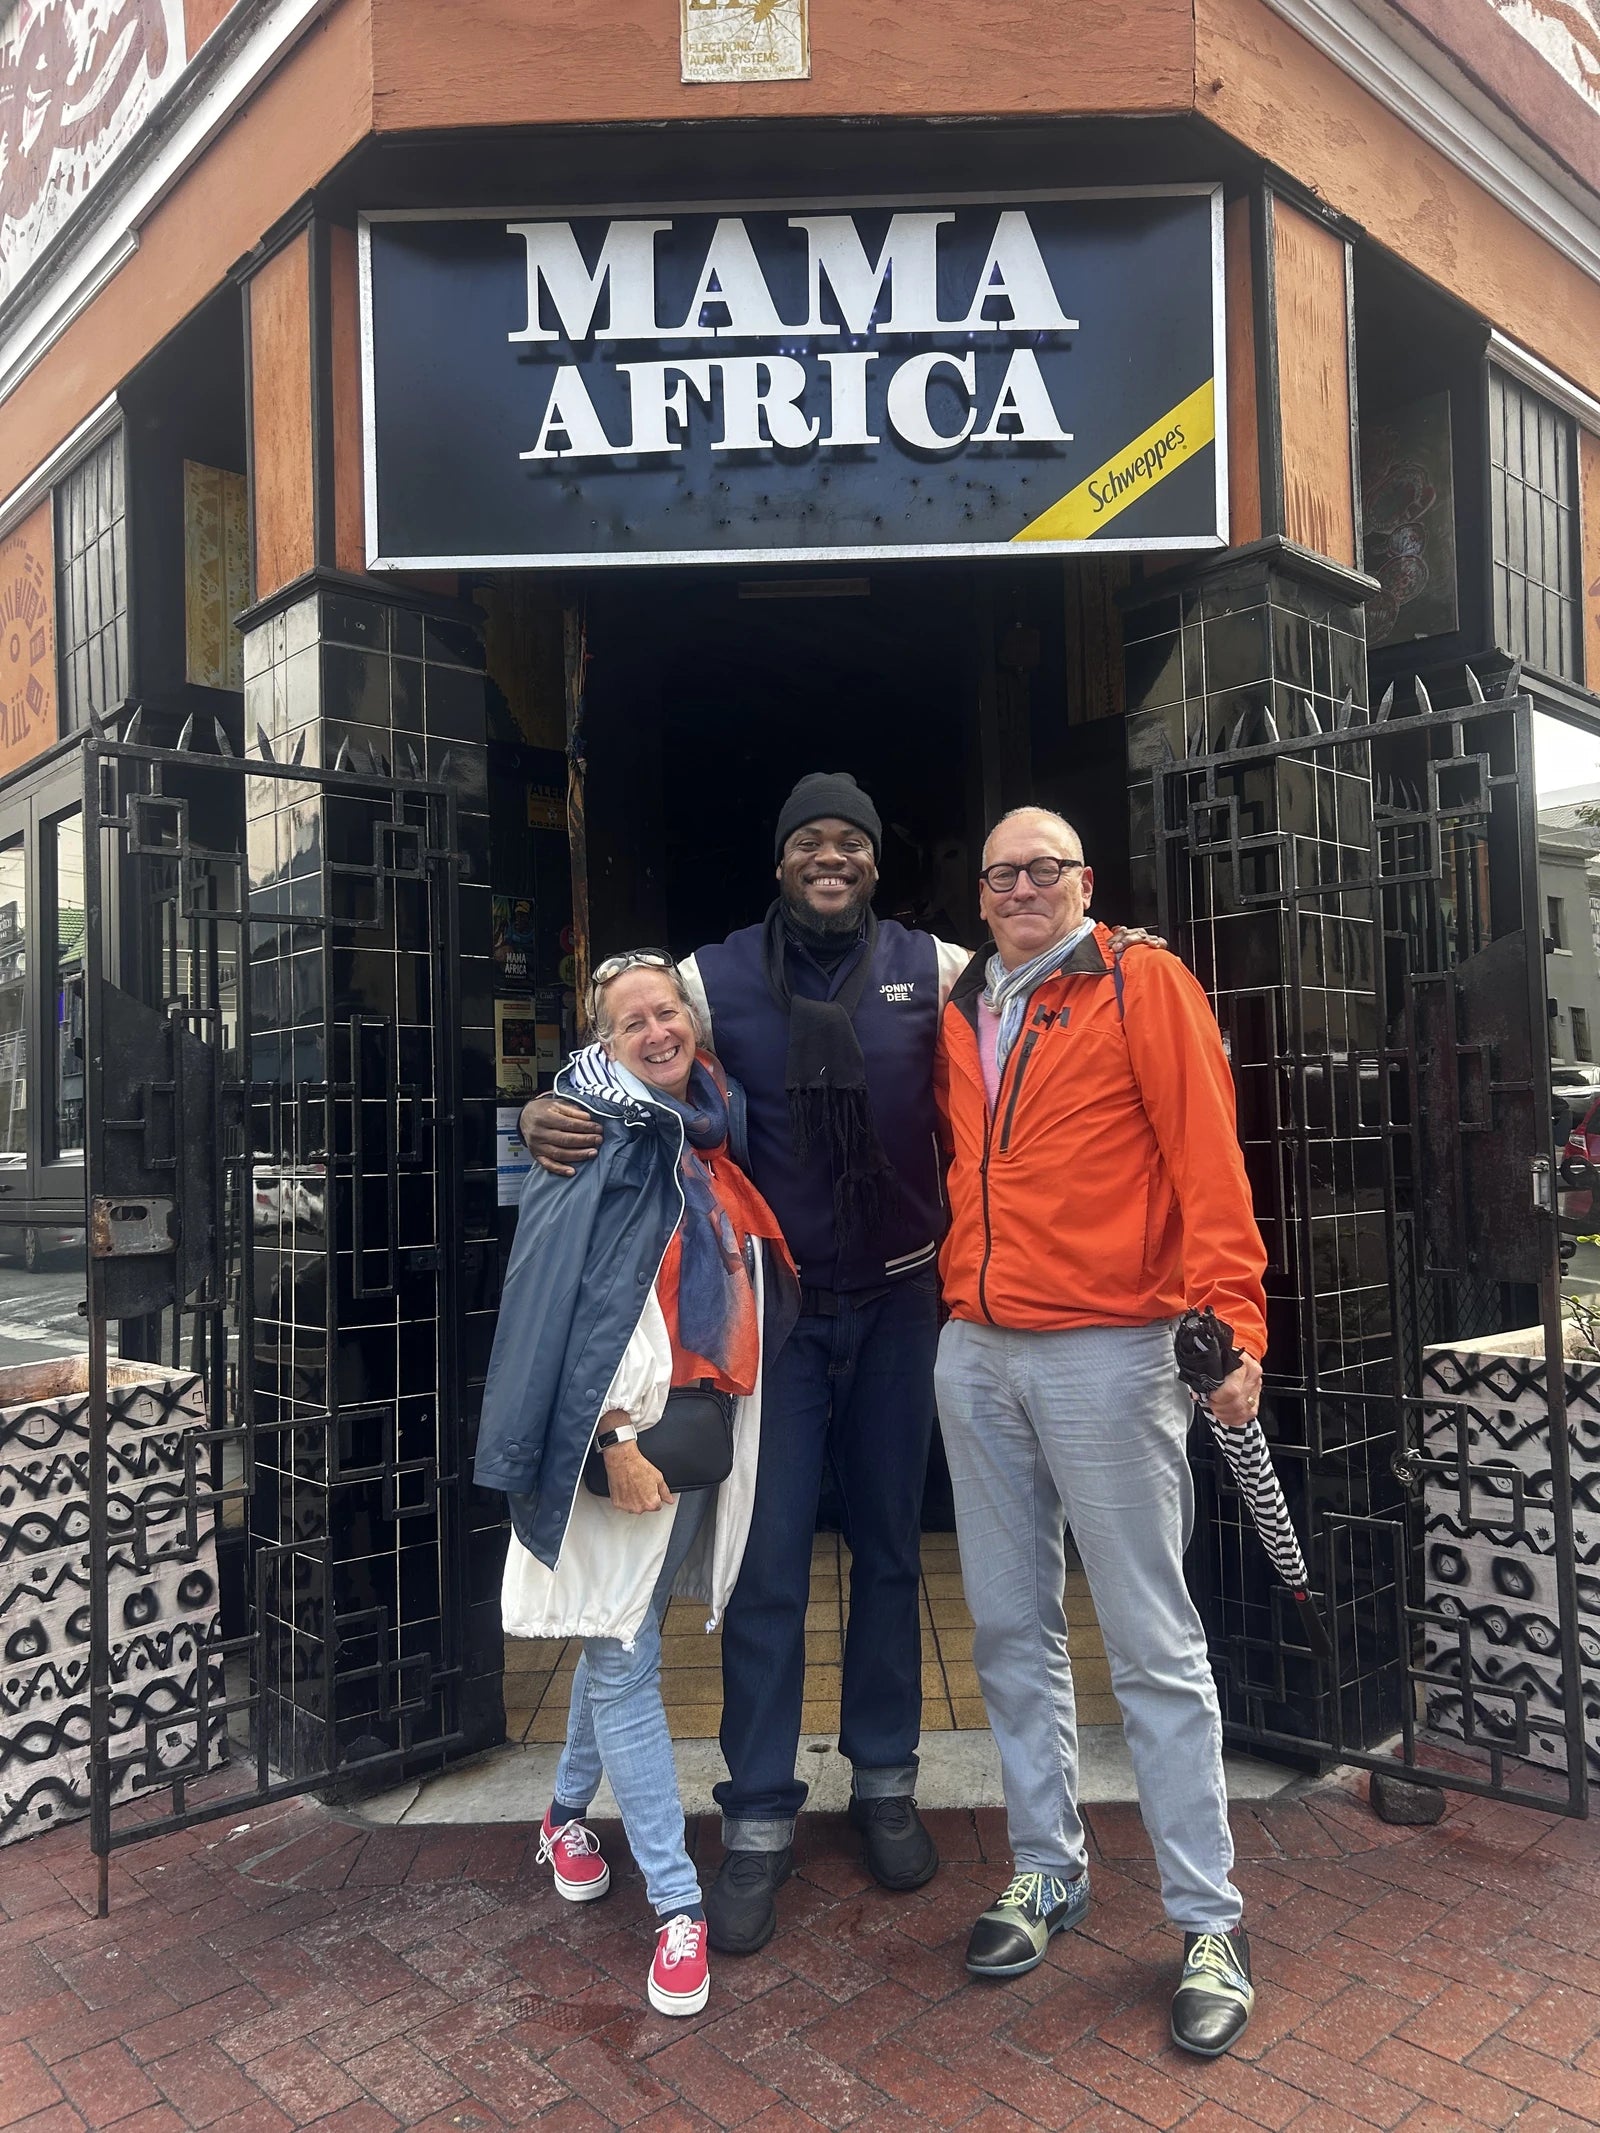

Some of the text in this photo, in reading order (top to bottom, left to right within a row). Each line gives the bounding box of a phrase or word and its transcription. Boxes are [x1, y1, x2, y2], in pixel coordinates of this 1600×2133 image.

[689, 41, 756, 53] ELECTRONIC
[690, 52, 780, 66] ALARM SYSTEMS
[506, 211, 1079, 342] MAMA
[519, 348, 1074, 460] AFRICA
[1088, 424, 1185, 513] Schweppes
[506, 952, 527, 964] MAMA
[504, 963, 528, 975] AFRICA
[879, 983, 914, 993] JONNY
